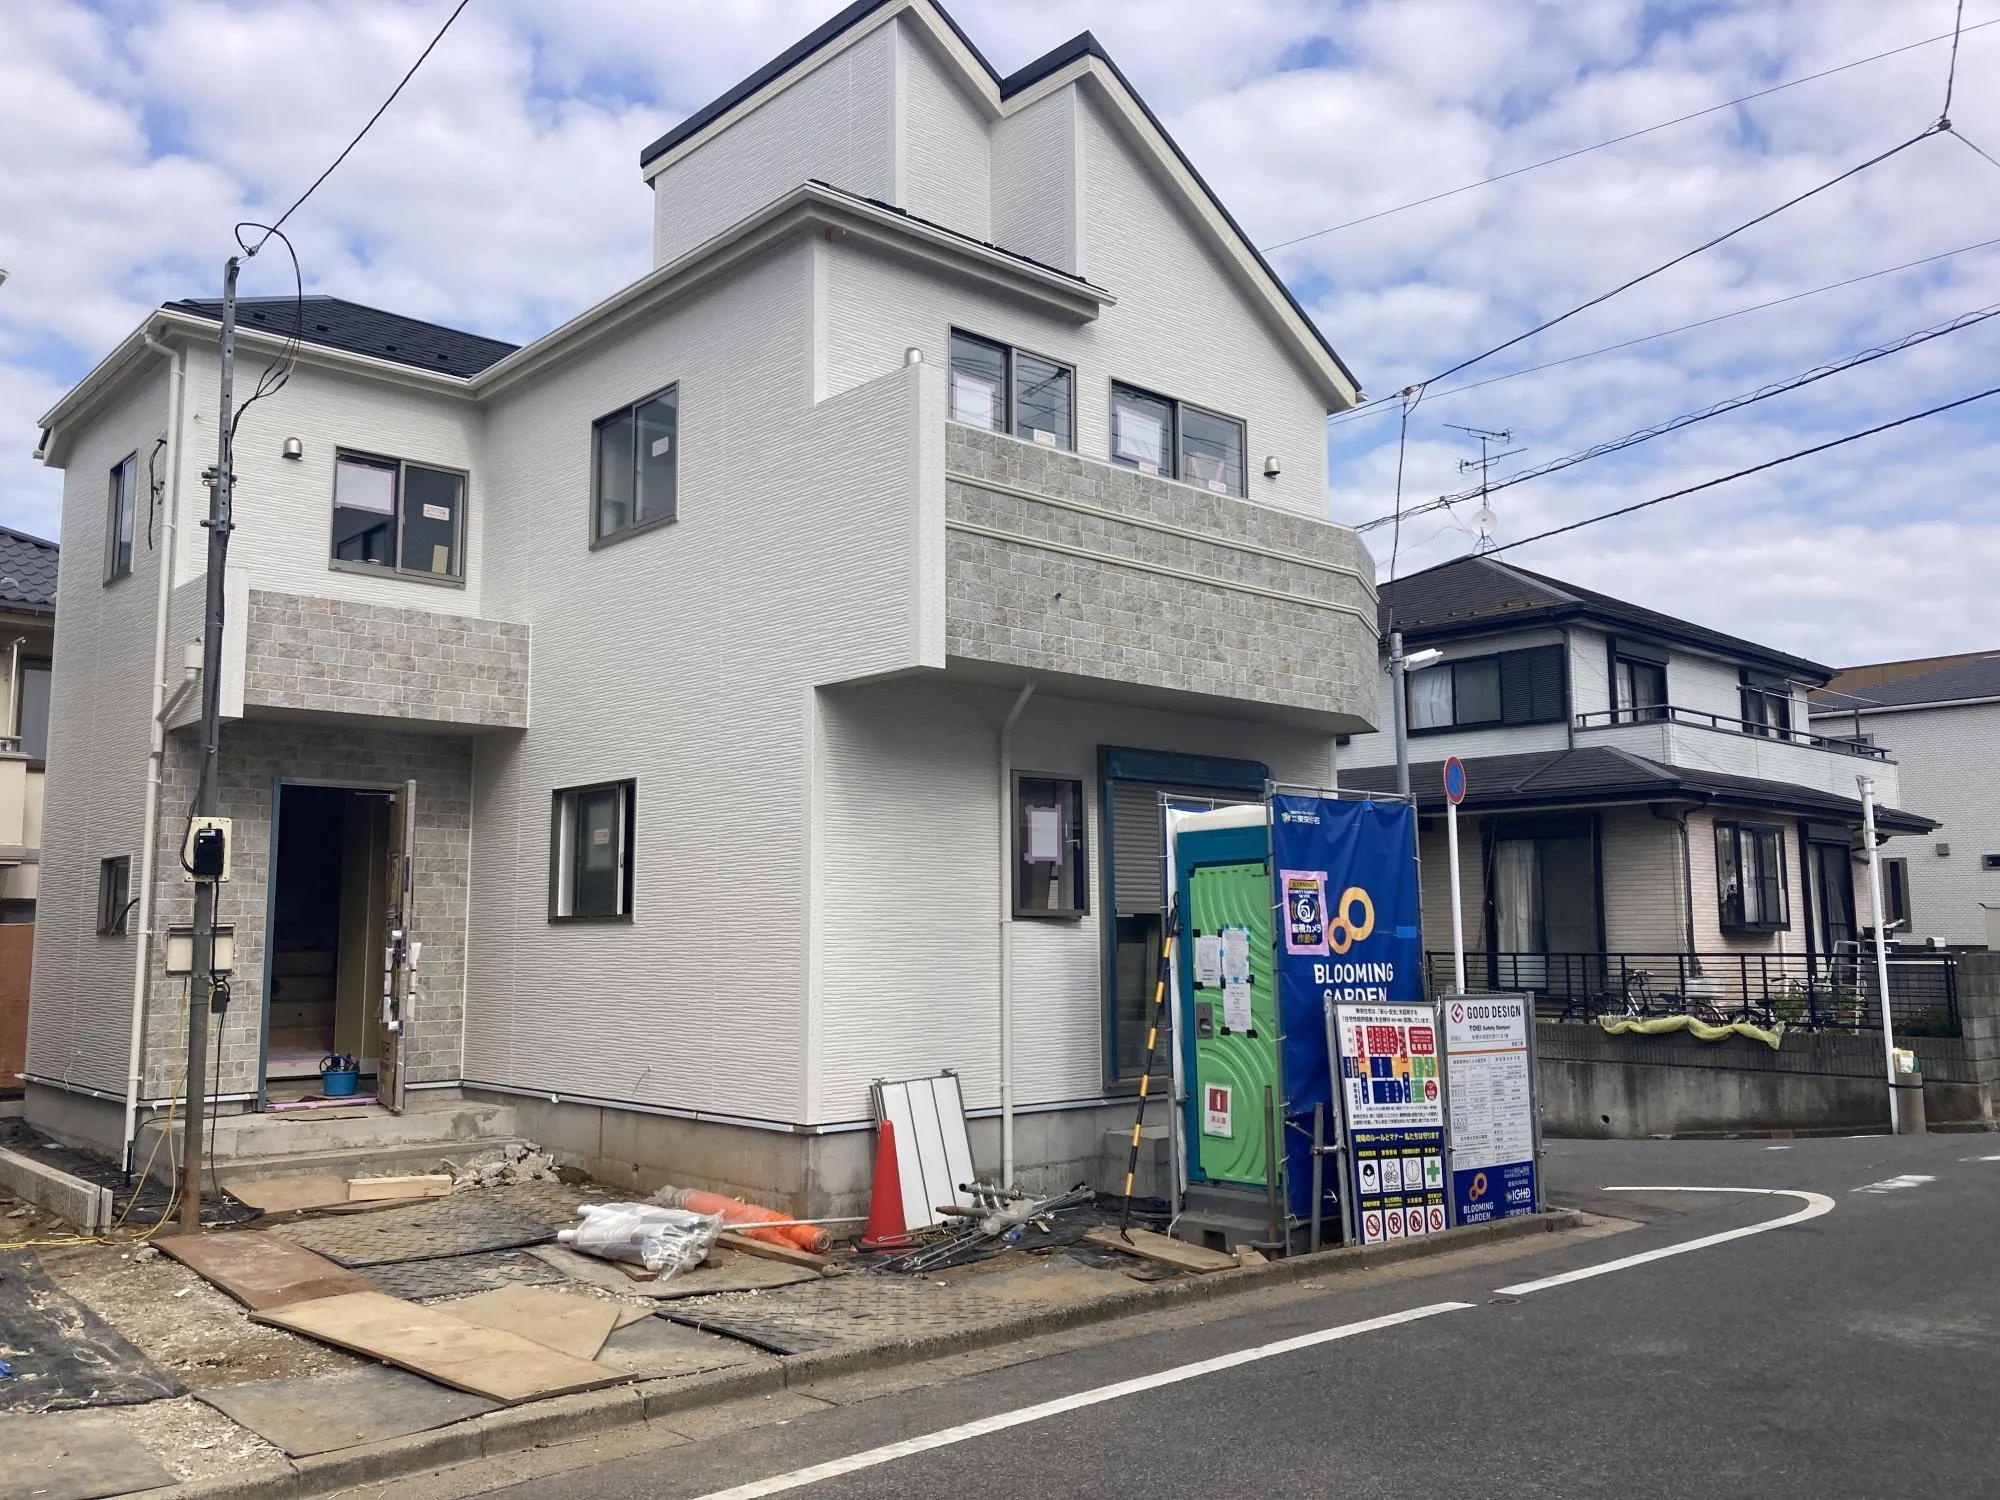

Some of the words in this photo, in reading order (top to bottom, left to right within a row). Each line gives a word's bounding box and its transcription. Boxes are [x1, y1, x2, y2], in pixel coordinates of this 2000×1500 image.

[1291, 923, 1322, 933] 監視カメラ
[1296, 934, 1317, 944] 作動中
[1313, 962, 1394, 985] BLOOMING
[1467, 1006, 1490, 1019] GOOD
[1492, 1005, 1521, 1018] DESIGN
[1463, 1201, 1494, 1215] BLOOMING
[1466, 1212, 1491, 1224] GARDEN
